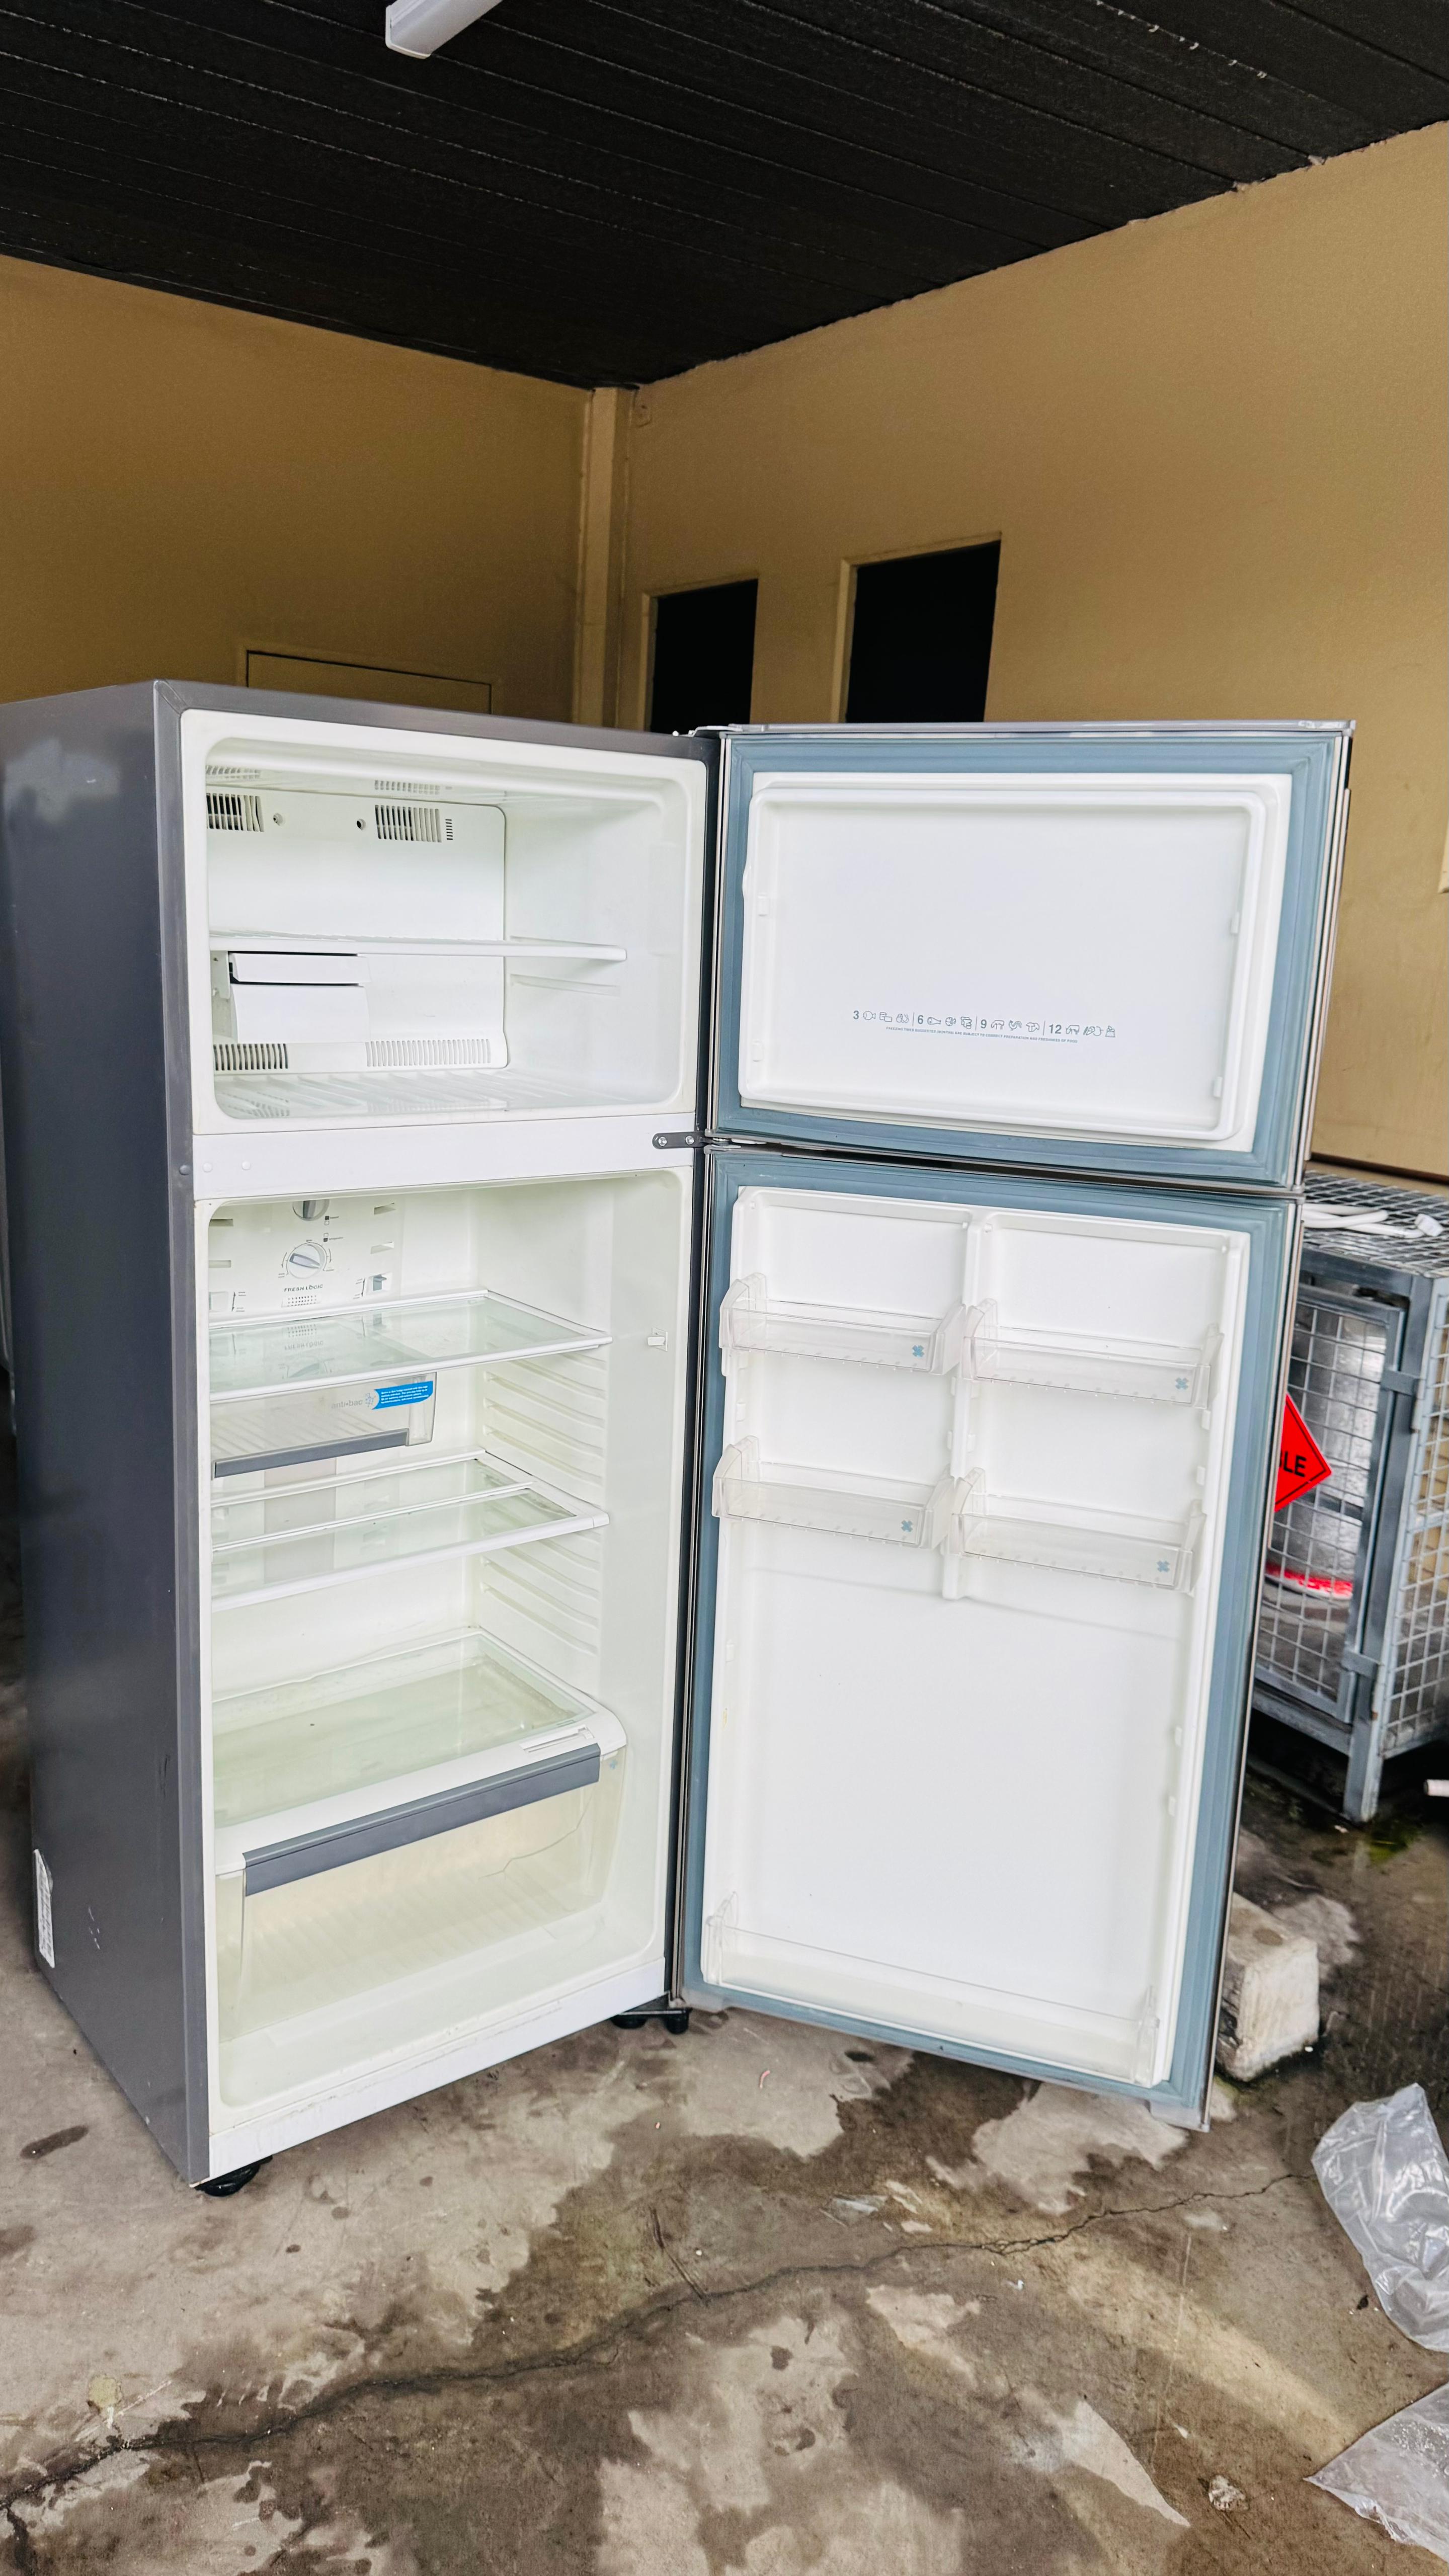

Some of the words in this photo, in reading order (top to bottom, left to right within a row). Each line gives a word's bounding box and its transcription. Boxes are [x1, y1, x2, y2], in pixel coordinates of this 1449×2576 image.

[853, 1010, 859, 1020] 3
[917, 1015, 924, 1024] 6
[981, 1019, 987, 1029] 9
[1049, 1024, 1062, 1034] 12
[1279, 1451, 1307, 1478] LE
